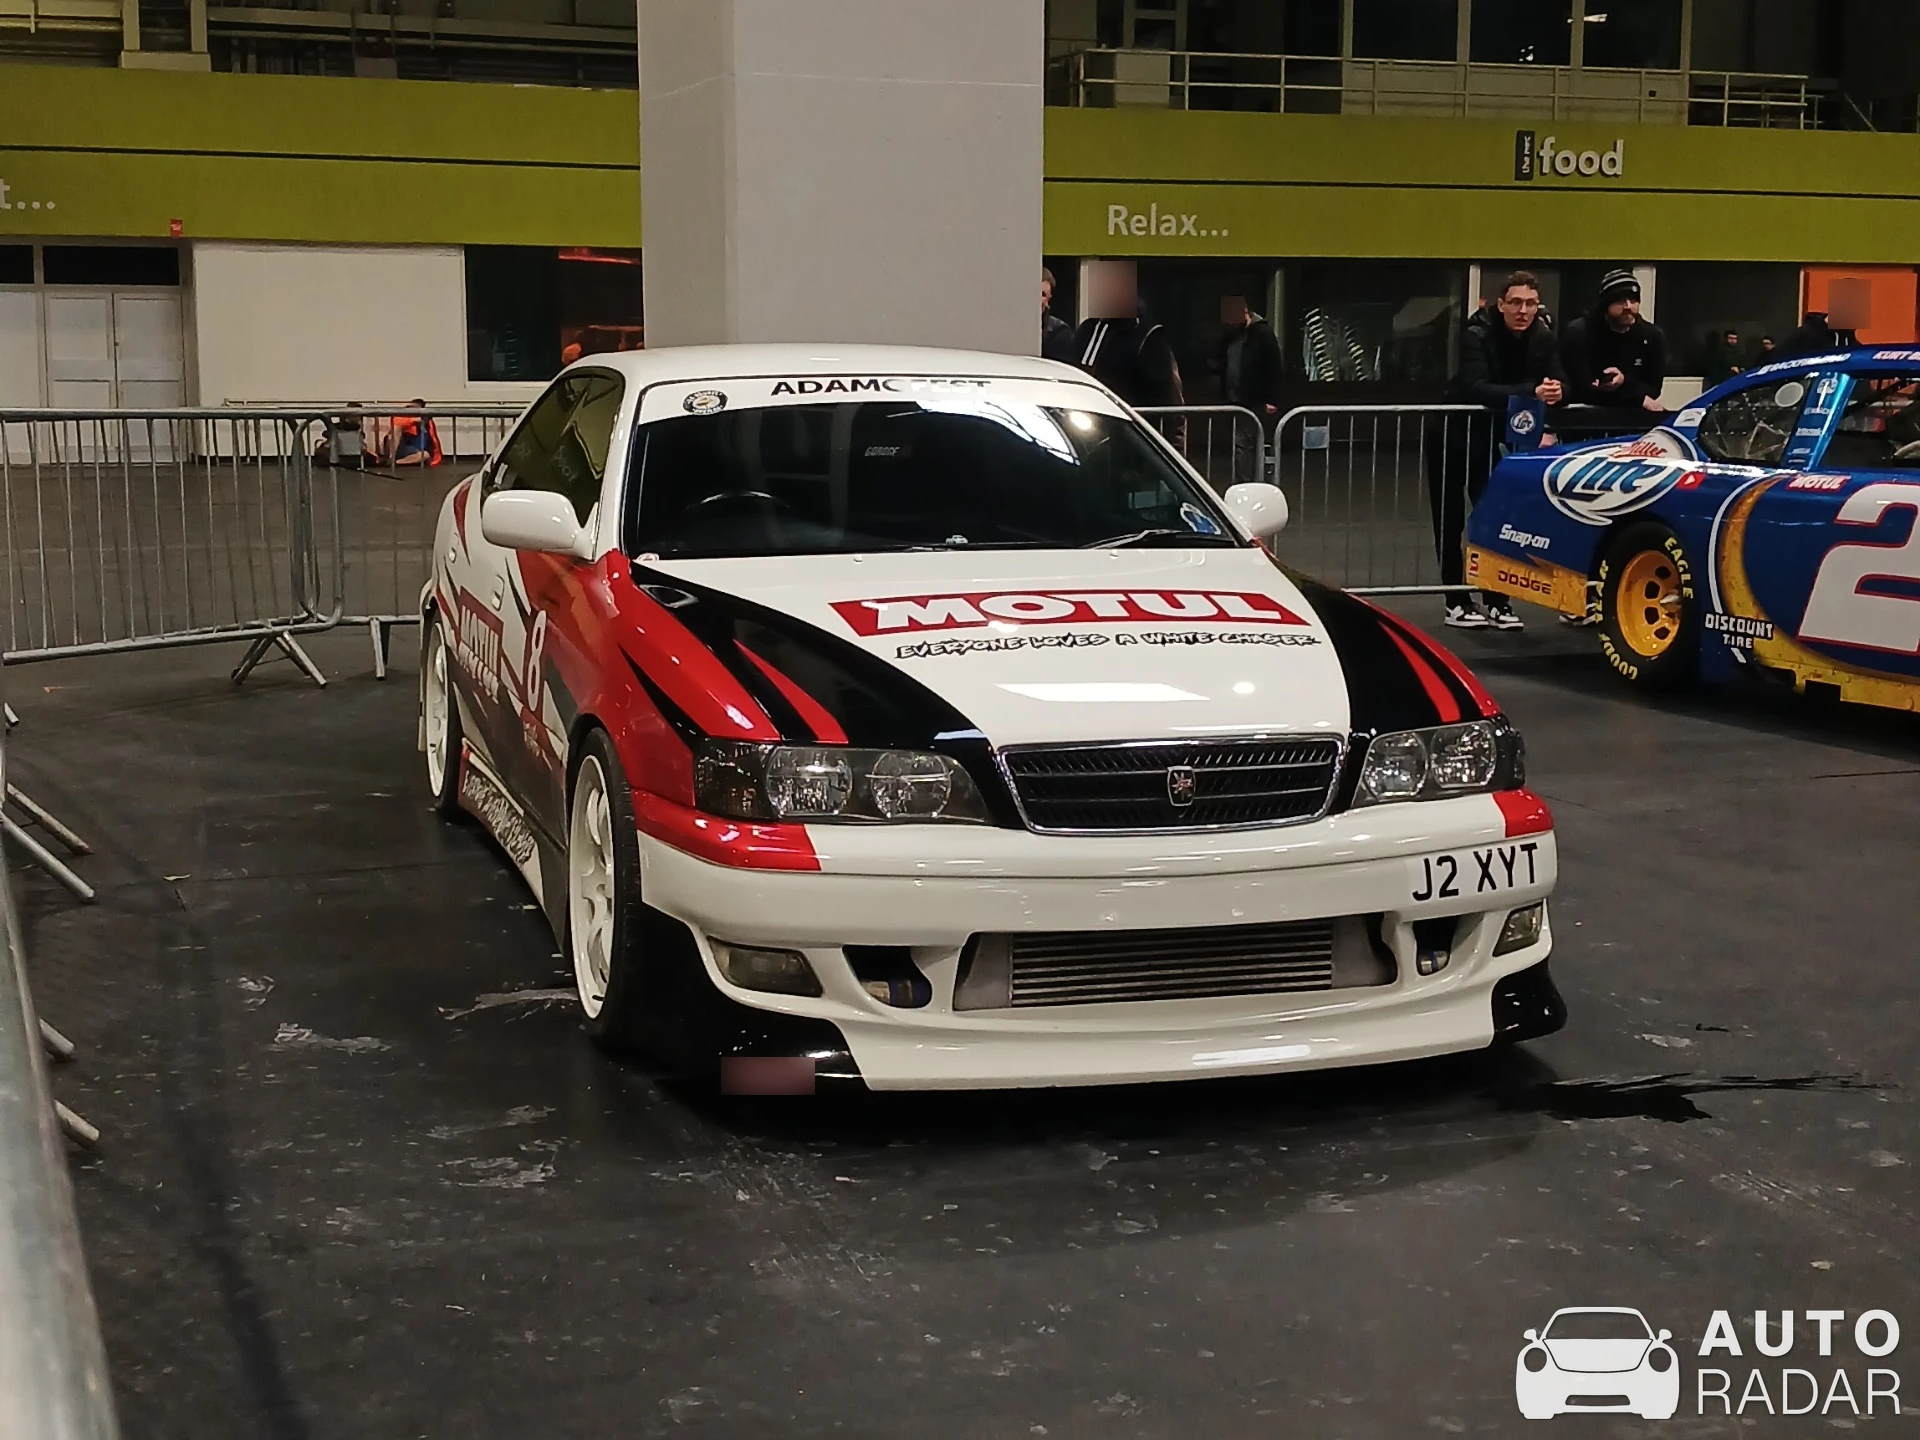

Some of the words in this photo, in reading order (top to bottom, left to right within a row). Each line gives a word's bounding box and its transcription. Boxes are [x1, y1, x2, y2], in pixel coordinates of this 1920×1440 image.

[1539, 136, 1624, 175] food
[1107, 202, 1229, 237] Relax...
[1557, 457, 1668, 503] Lite
[1789, 475, 1842, 489] MOTUL
[1499, 523, 1551, 550] Snap-on
[1498, 570, 1552, 595] DODGE
[1664, 536, 1694, 600] EAGLE
[1797, 481, 1920, 656] 2
[868, 593, 1282, 630] MOTUL
[1704, 612, 1774, 639] DISCOUNT
[893, 637, 1028, 659] EVERYONE
[1028, 632, 1110, 648] LOVES
[1114, 633, 1138, 646] A
[1140, 631, 1216, 648] WHITE
[1217, 632, 1323, 648] CHASER
[1722, 633, 1753, 649] TIRE
[527, 609, 547, 712] 8
[1412, 855, 1459, 902] J2
[1473, 842, 1538, 893] XYT
